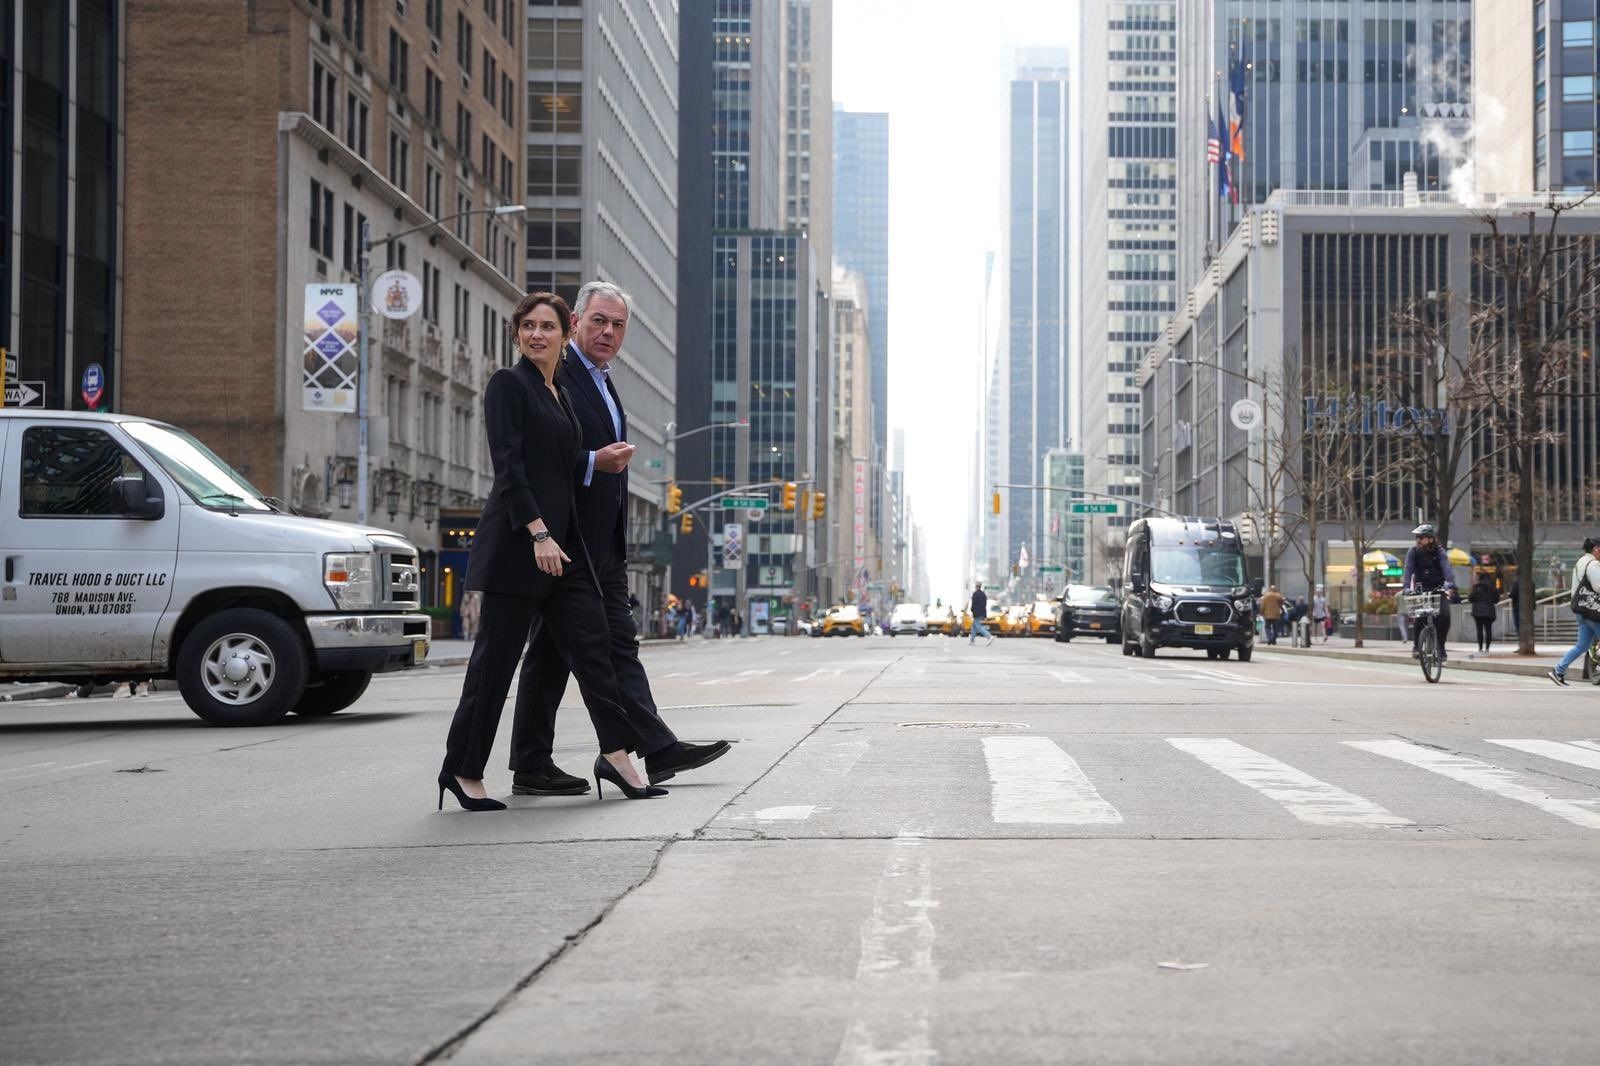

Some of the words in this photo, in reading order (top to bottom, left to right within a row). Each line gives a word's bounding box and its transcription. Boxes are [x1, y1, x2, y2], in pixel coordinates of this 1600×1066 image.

[320, 288, 343, 296] NYC
[5, 390, 28, 400] WAY
[1304, 394, 1450, 434] Hilton
[29, 573, 68, 586] TRAVEL
[72, 573, 101, 586] HOOD
[104, 573, 112, 586] &
[115, 573, 144, 586] DUCT
[146, 573, 167, 586] LLC
[88, 604, 99, 615] NJ
[102, 604, 132, 615] 07083
